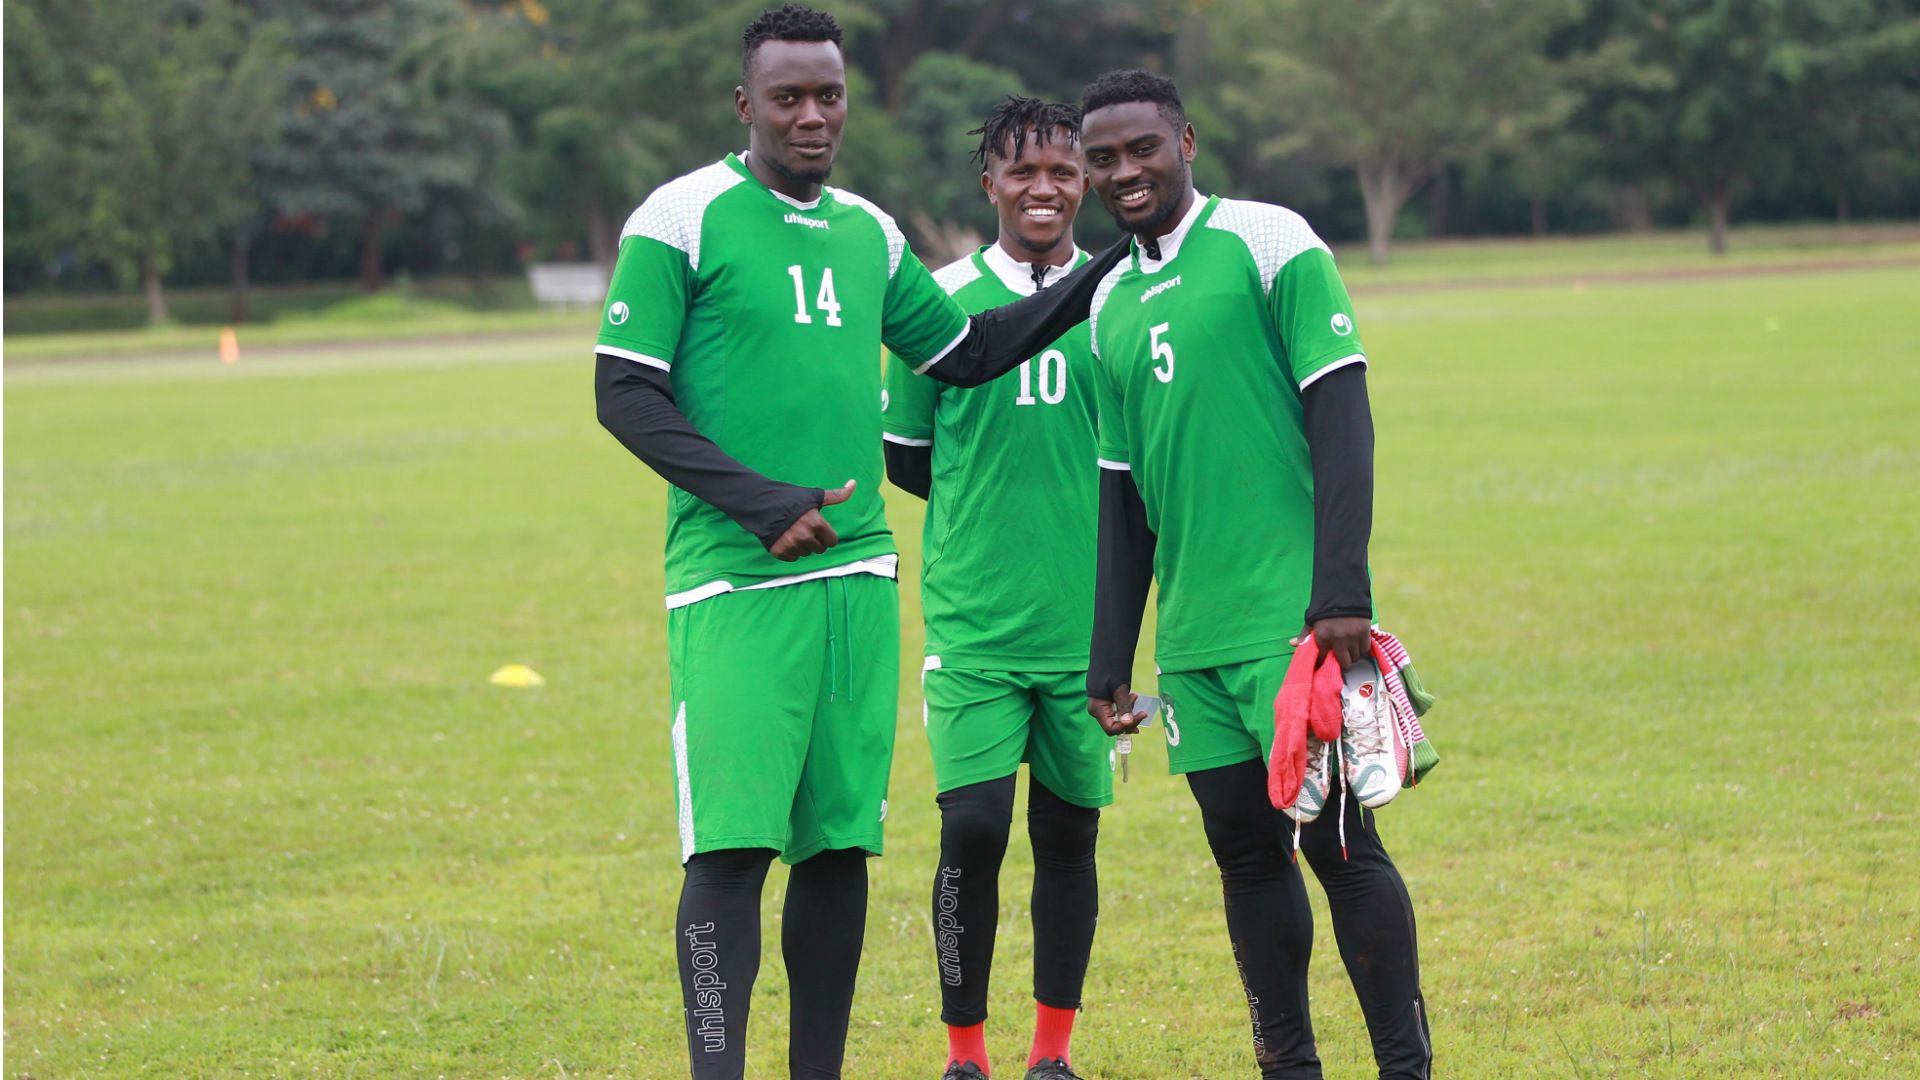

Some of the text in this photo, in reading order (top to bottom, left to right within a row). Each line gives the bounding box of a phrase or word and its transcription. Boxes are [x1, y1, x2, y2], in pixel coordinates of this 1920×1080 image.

[784, 212, 830, 230] uhlsport
[787, 264, 842, 327] 14
[1140, 274, 1181, 304] uhlsport
[1015, 348, 1067, 406] 10
[1149, 321, 1175, 384] 5
[936, 865, 965, 988] uhlsport
[684, 921, 727, 1054] uhlsport
